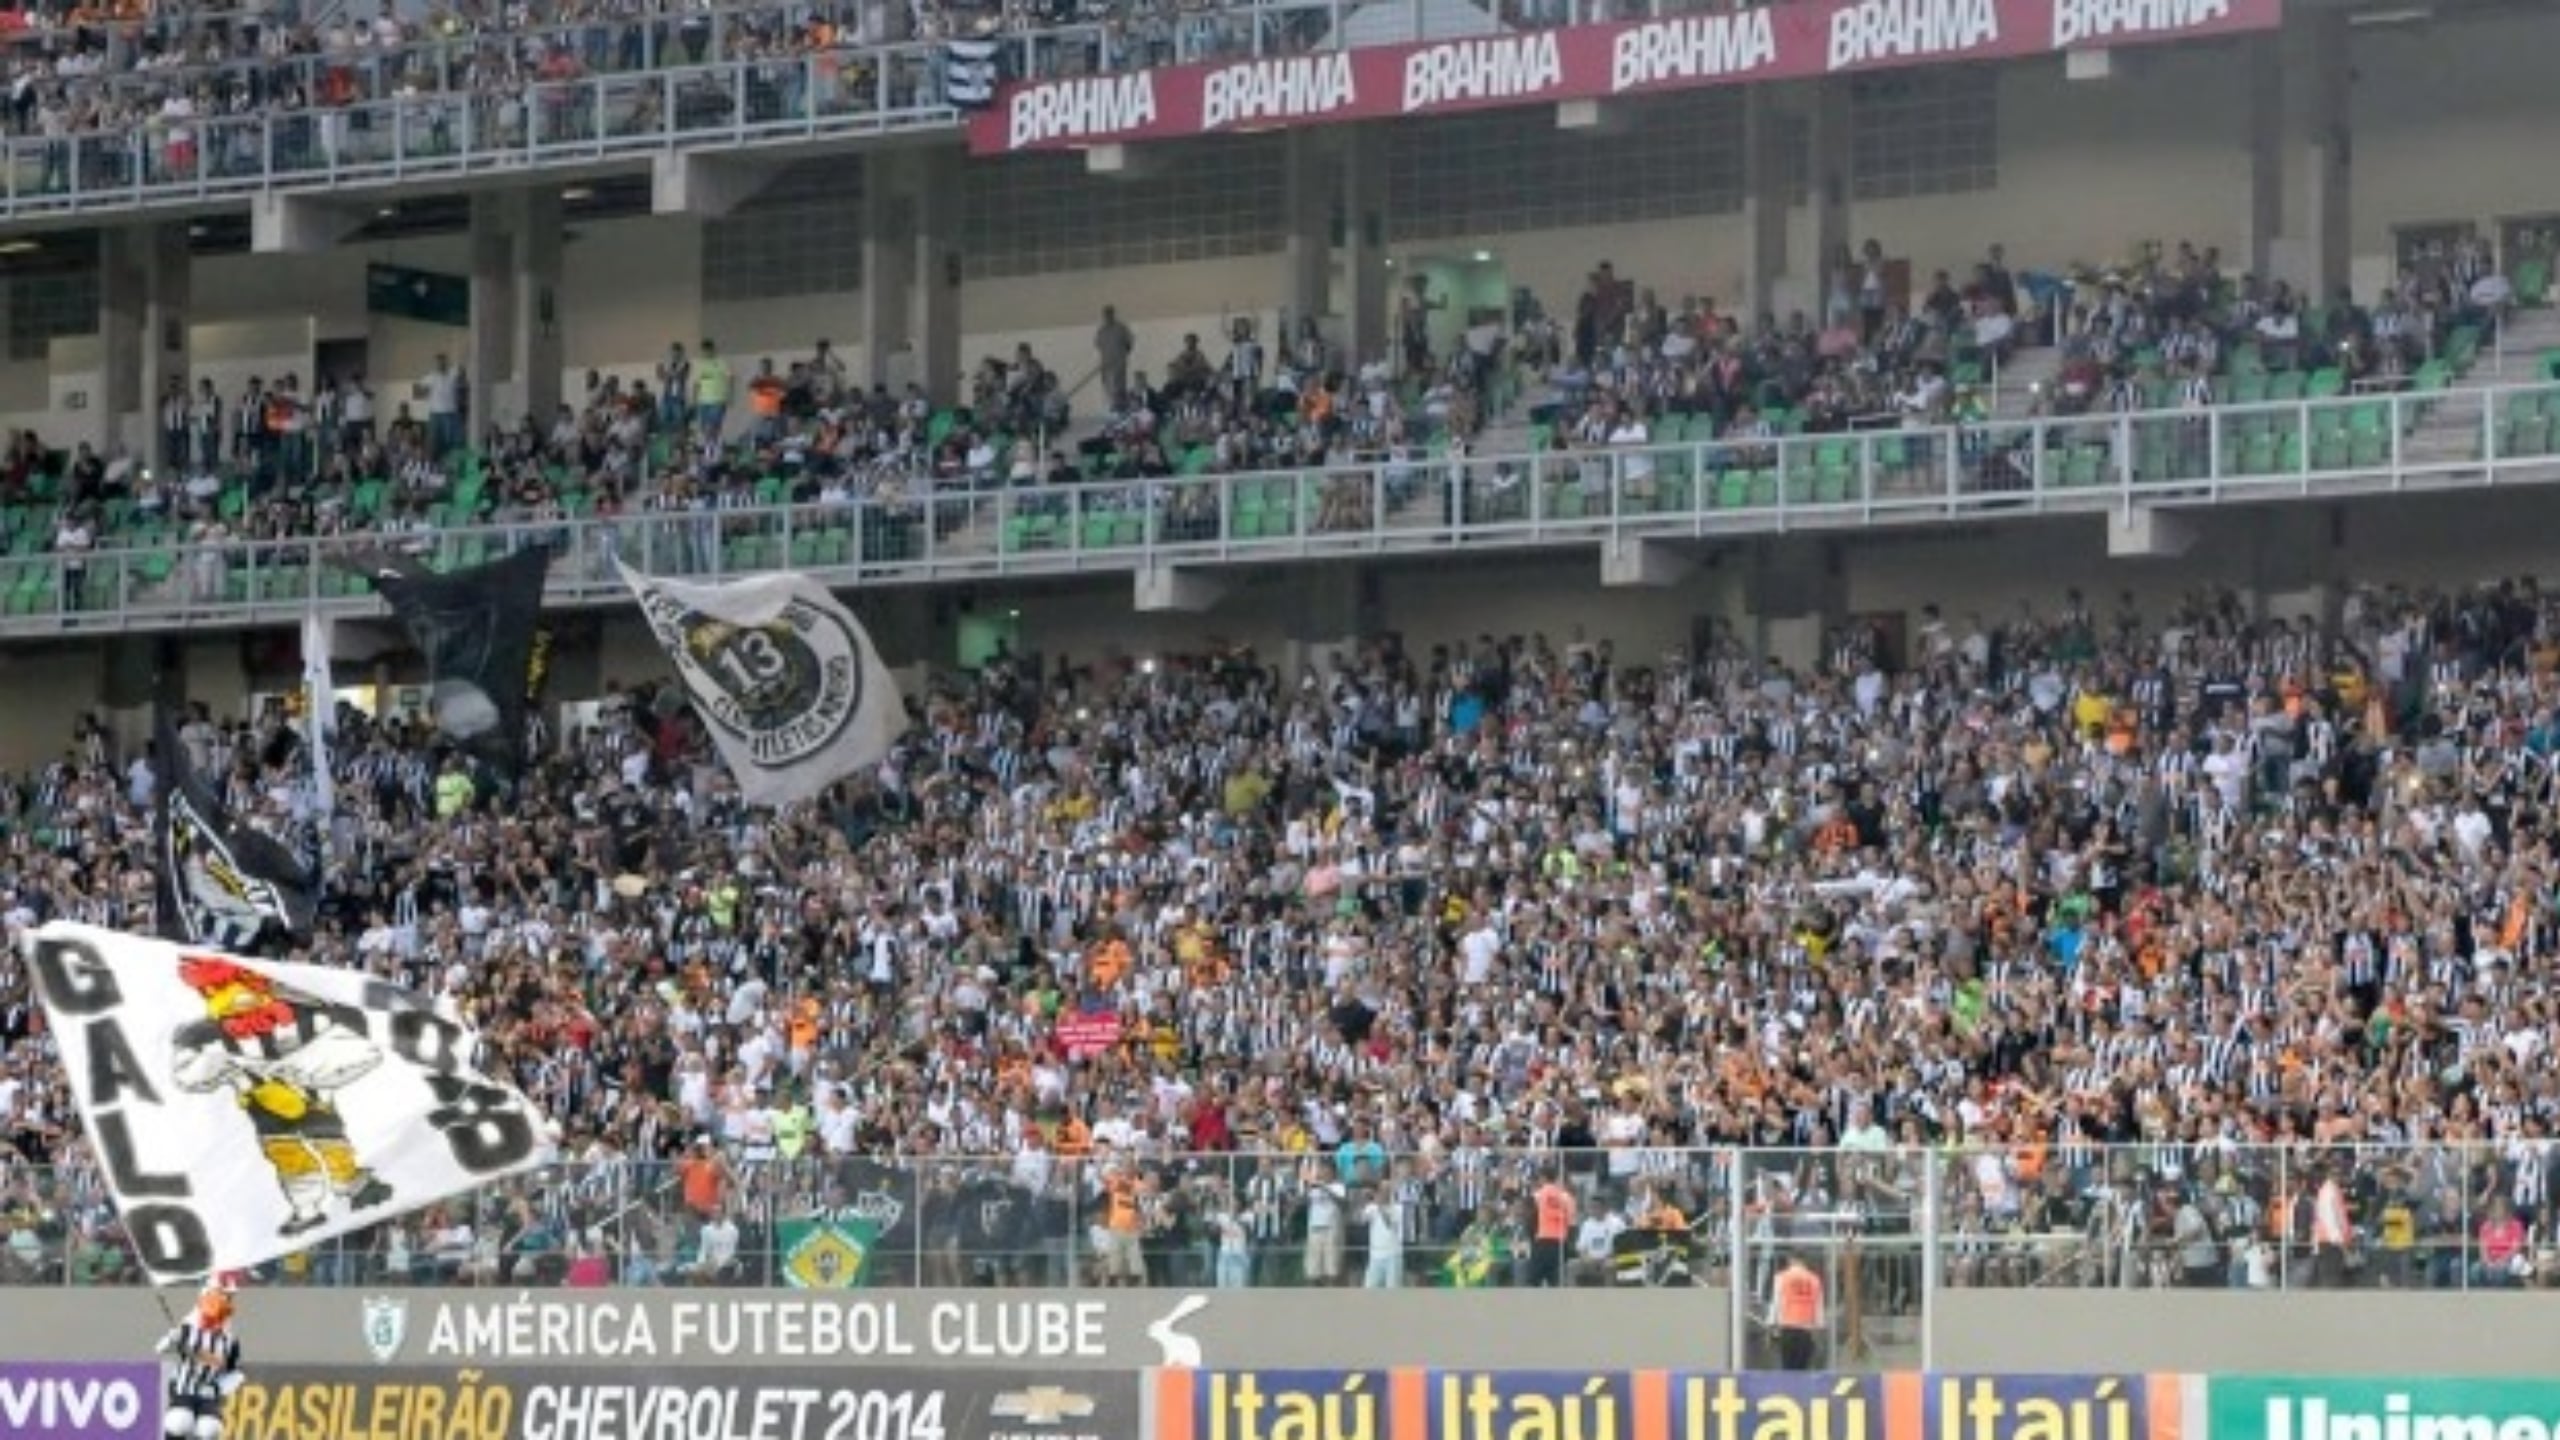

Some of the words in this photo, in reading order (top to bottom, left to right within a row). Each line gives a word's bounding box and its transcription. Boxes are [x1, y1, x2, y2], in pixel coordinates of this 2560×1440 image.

[1612, 8, 1774, 92] BRAHMA
[1827, 0, 1997, 70] BRAHMA
[1202, 53, 1354, 129] BRAHMA
[1404, 31, 1562, 112] BRAHMA
[1009, 71, 1156, 149] BRAHMA
[717, 630, 786, 694] 13
[34, 938, 213, 1273] GALO
[428, 1292, 656, 1356] AMÉRICA
[672, 1301, 914, 1356] FUTEBOL
[930, 1301, 1107, 1355] CLUBE
[523, 1385, 820, 1440] CHEVROLET
[825, 1390, 946, 1440] 2014
[1210, 1373, 1375, 1440] Itaú
[1442, 1374, 1616, 1440] Itaú
[1686, 1377, 1866, 1440] Itaú
[1941, 1377, 2130, 1440] Itaú
[2266, 1394, 2560, 1440] Unime
